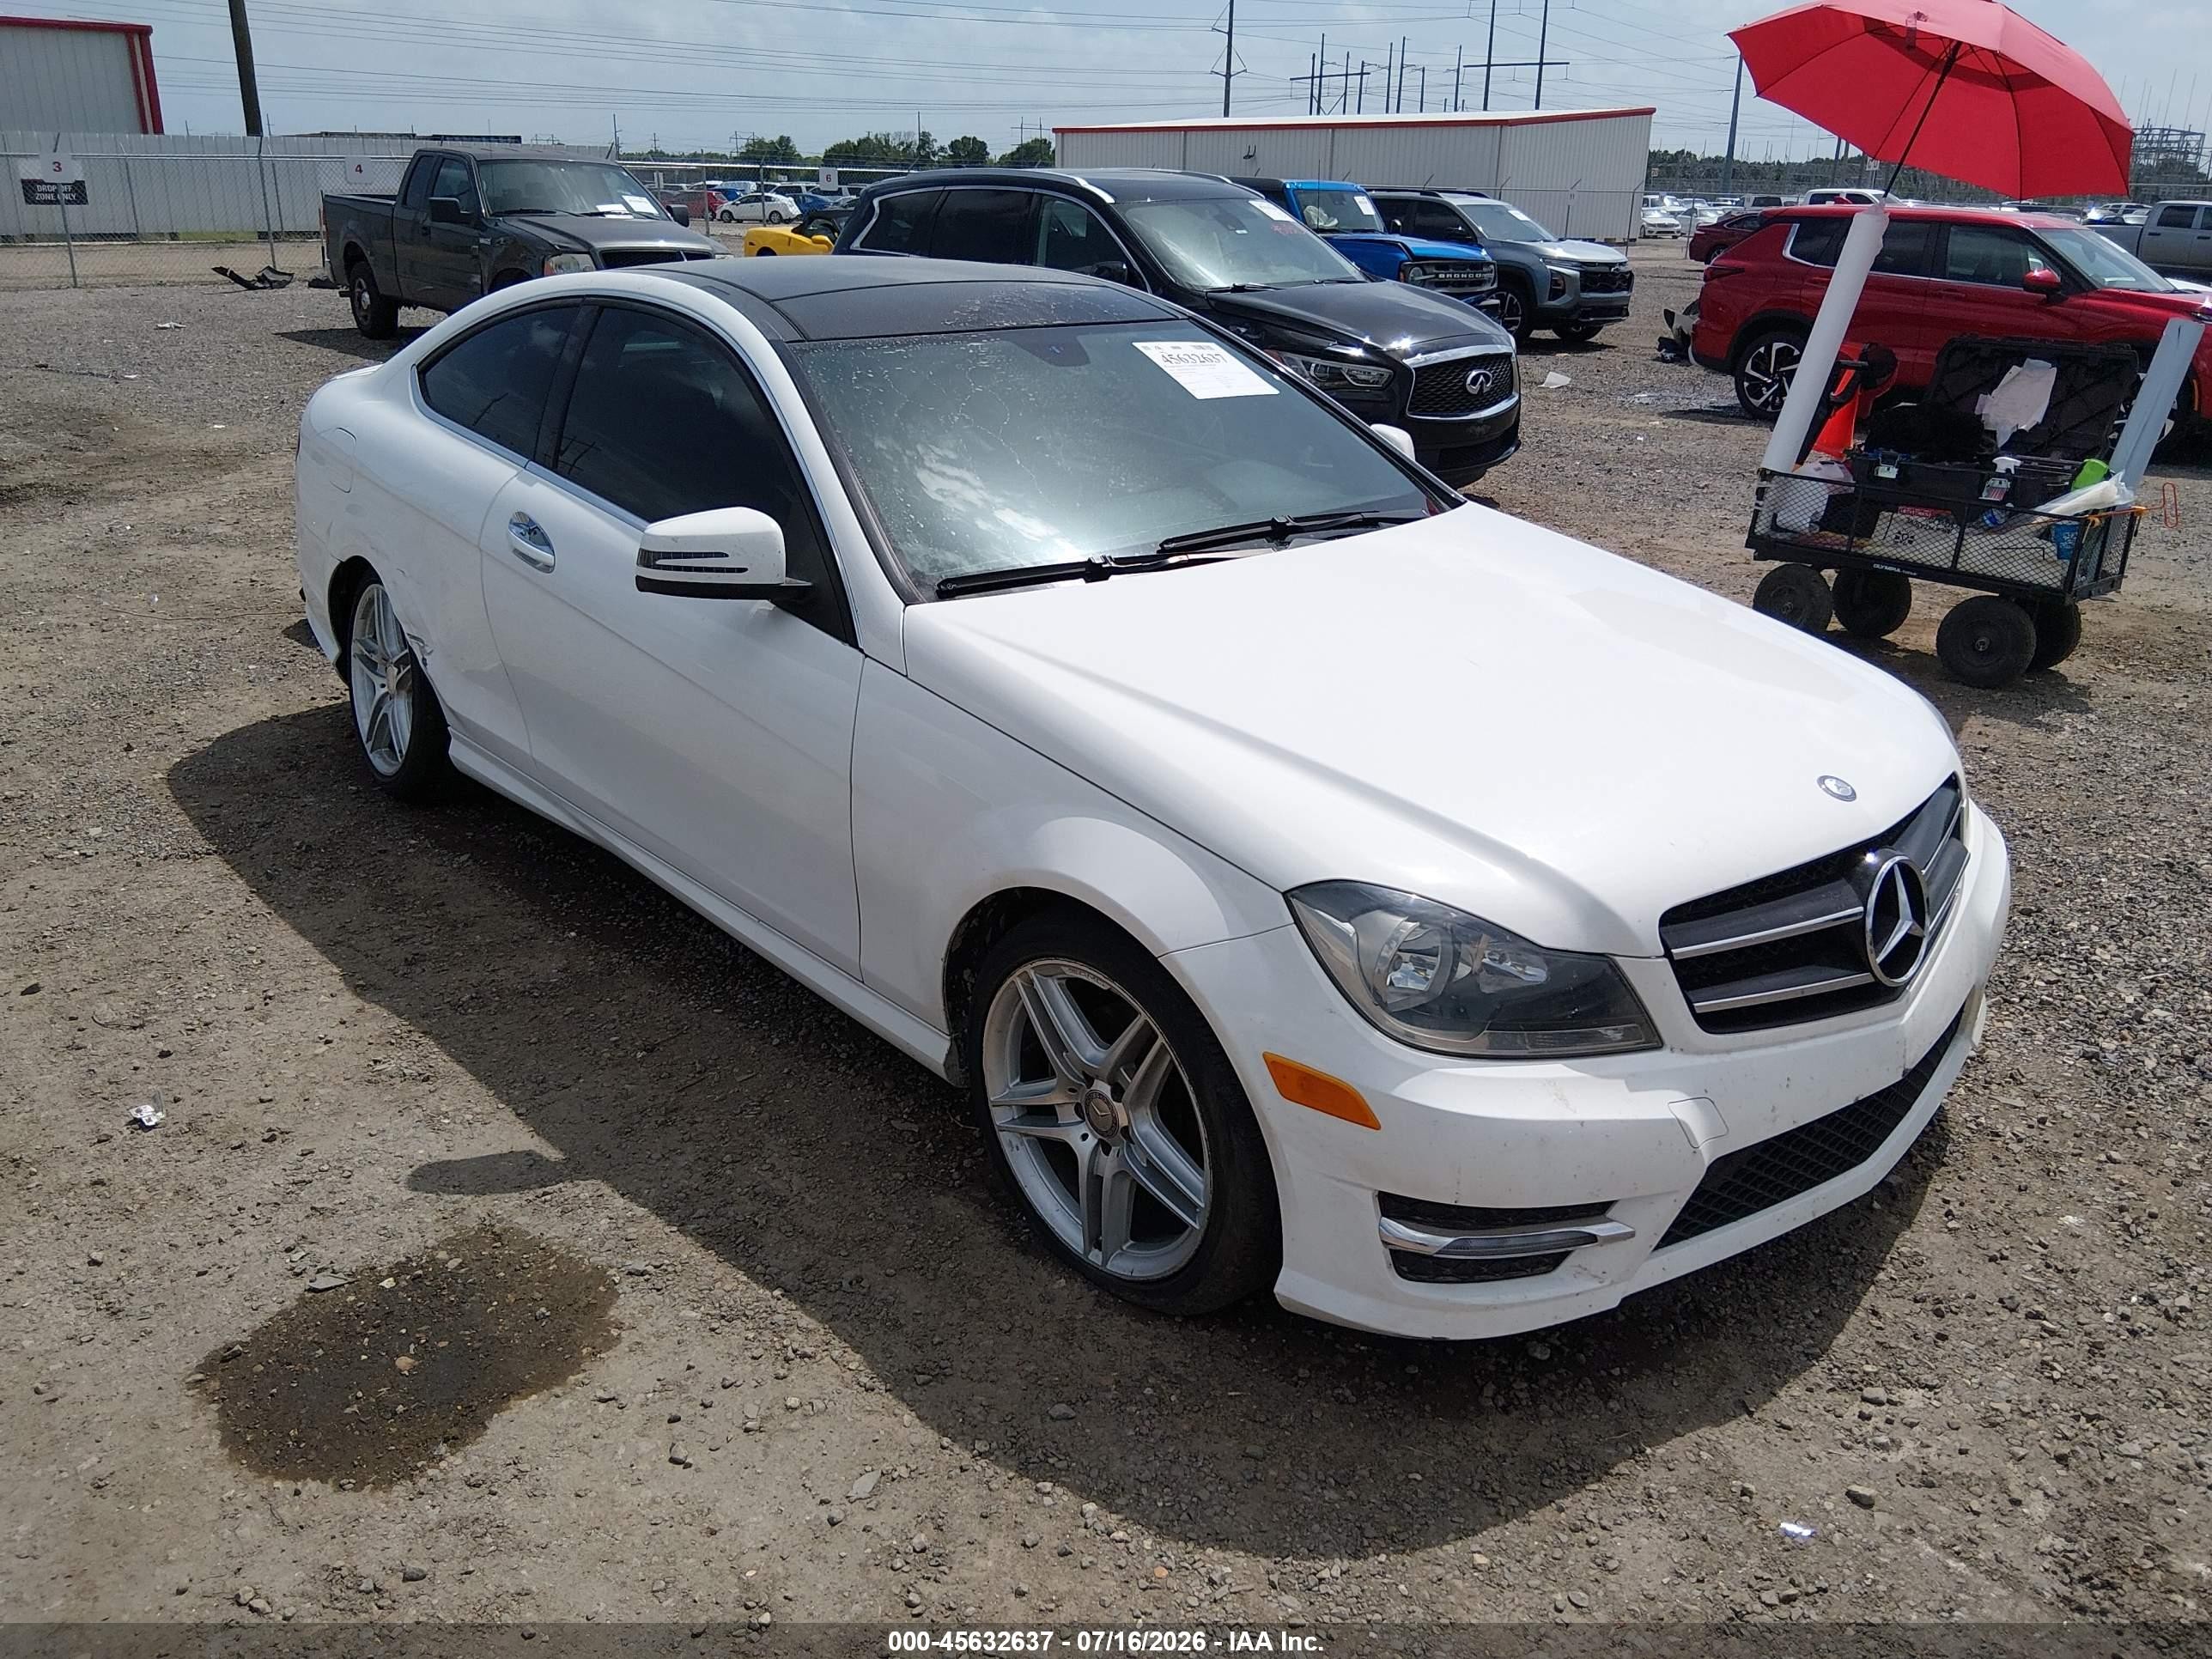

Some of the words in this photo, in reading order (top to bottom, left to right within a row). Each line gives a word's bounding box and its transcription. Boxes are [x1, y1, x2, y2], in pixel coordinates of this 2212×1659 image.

[52, 161, 63, 173] 3
[355, 164, 364, 174] 4
[825, 173, 832, 183] 6
[35, 192, 56, 201] ZONE
[1161, 353, 1228, 365] 45632637
